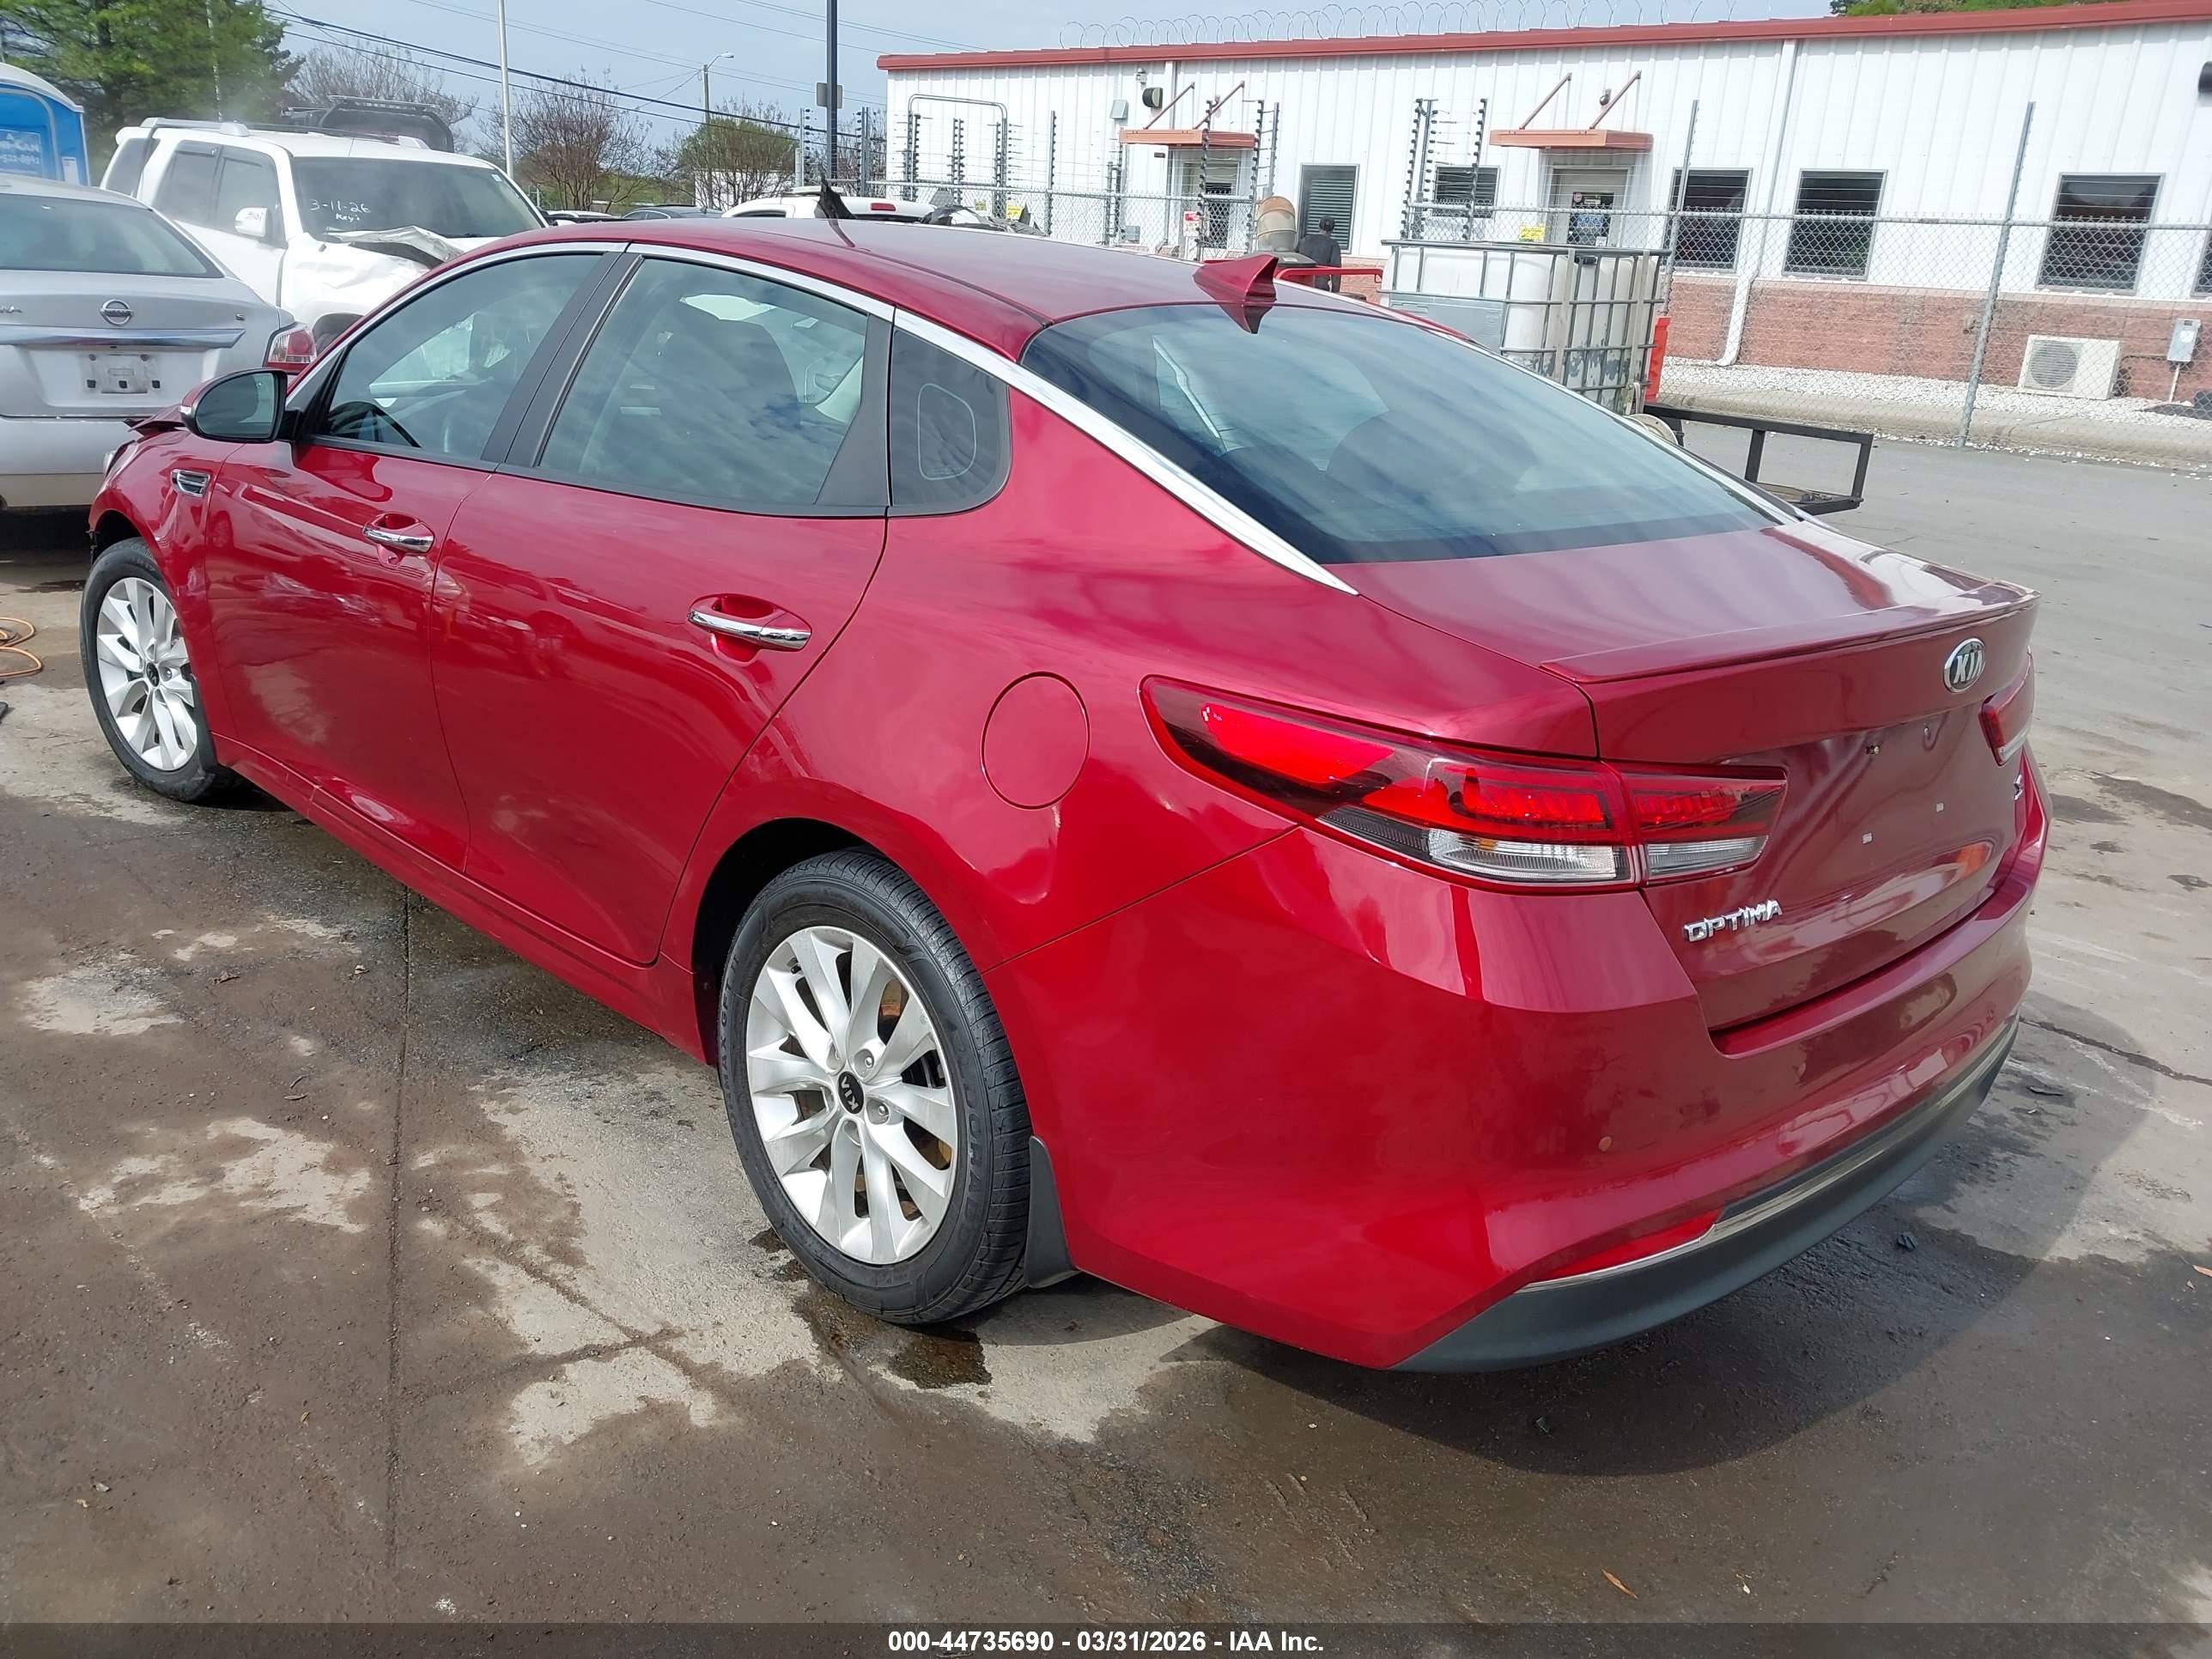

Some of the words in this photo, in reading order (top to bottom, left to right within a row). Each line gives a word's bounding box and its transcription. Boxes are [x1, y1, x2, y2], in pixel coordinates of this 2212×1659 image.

[309, 198, 372, 214] 3-11-26
[1953, 650, 1983, 684] KIA
[1683, 899, 1784, 942] OPTIMA
[841, 1075, 860, 1111] KIA
